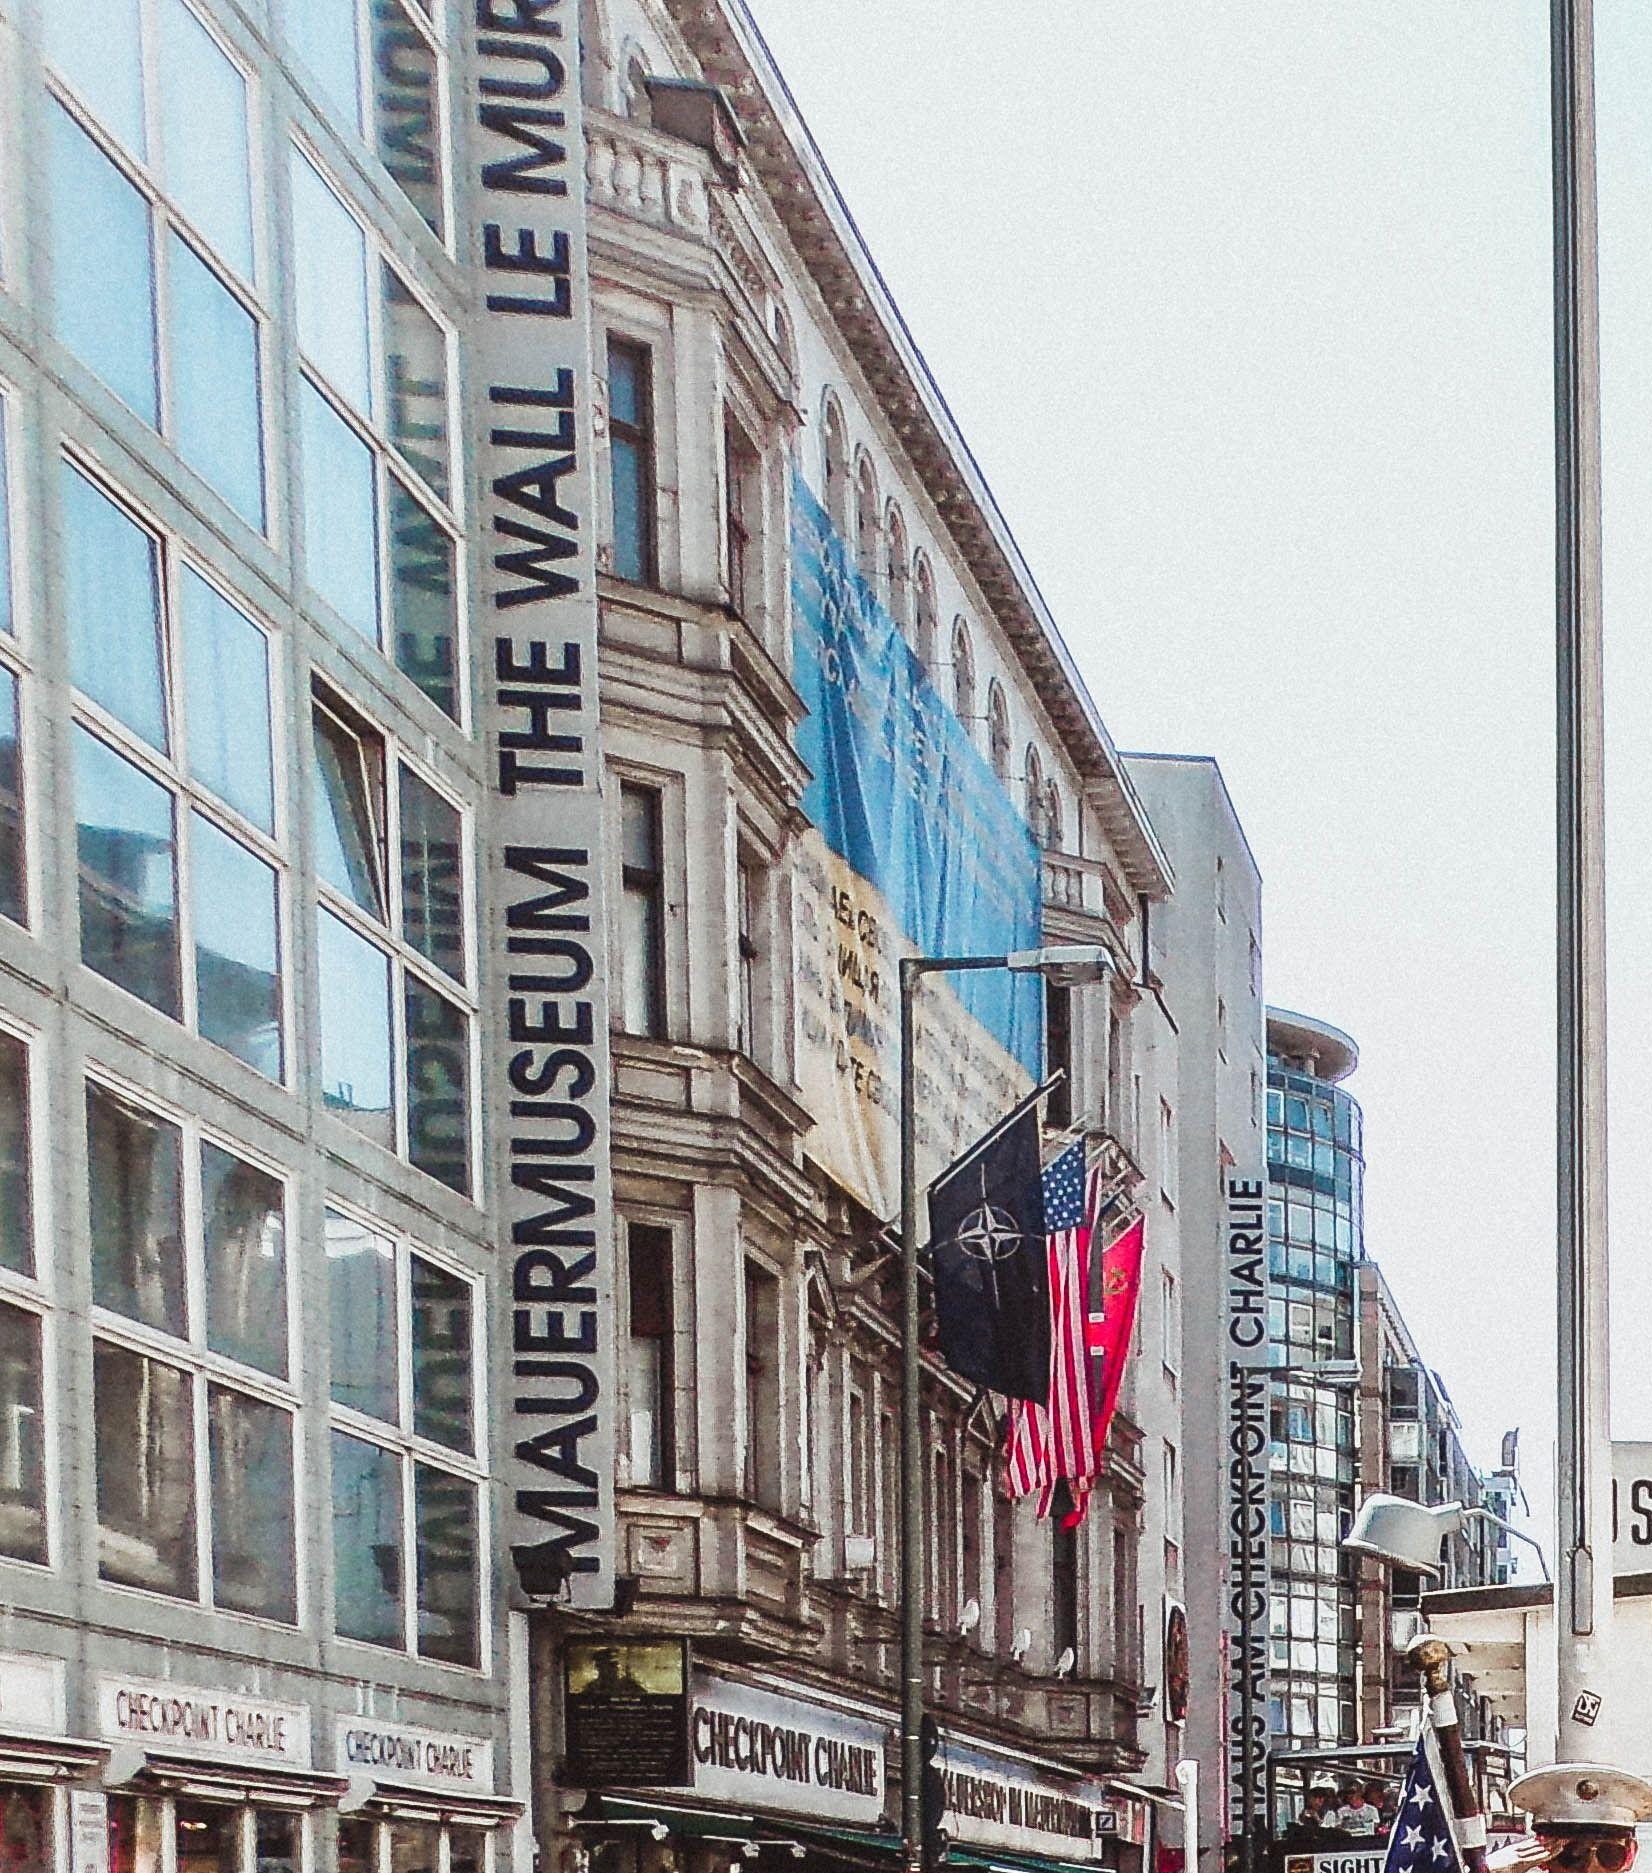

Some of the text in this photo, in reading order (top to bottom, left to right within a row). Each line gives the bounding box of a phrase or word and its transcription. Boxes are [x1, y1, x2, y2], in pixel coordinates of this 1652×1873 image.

[484, 224, 573, 319] LE
[489, 367, 582, 610] WALL
[495, 637, 585, 796] THE
[506, 846, 600, 1574] MAUERMUSEUM
[1229, 1179, 1267, 1836] HAUS AM CHECKPOINT CHARLIE
[116, 1689, 287, 1753] CHECKPOINT CHARLIE
[346, 1729, 474, 1779] CHECKPOINT CHARLIE
[693, 1706, 811, 1783] CHECKPOINT
[815, 1736, 877, 1798] CHARLIE
